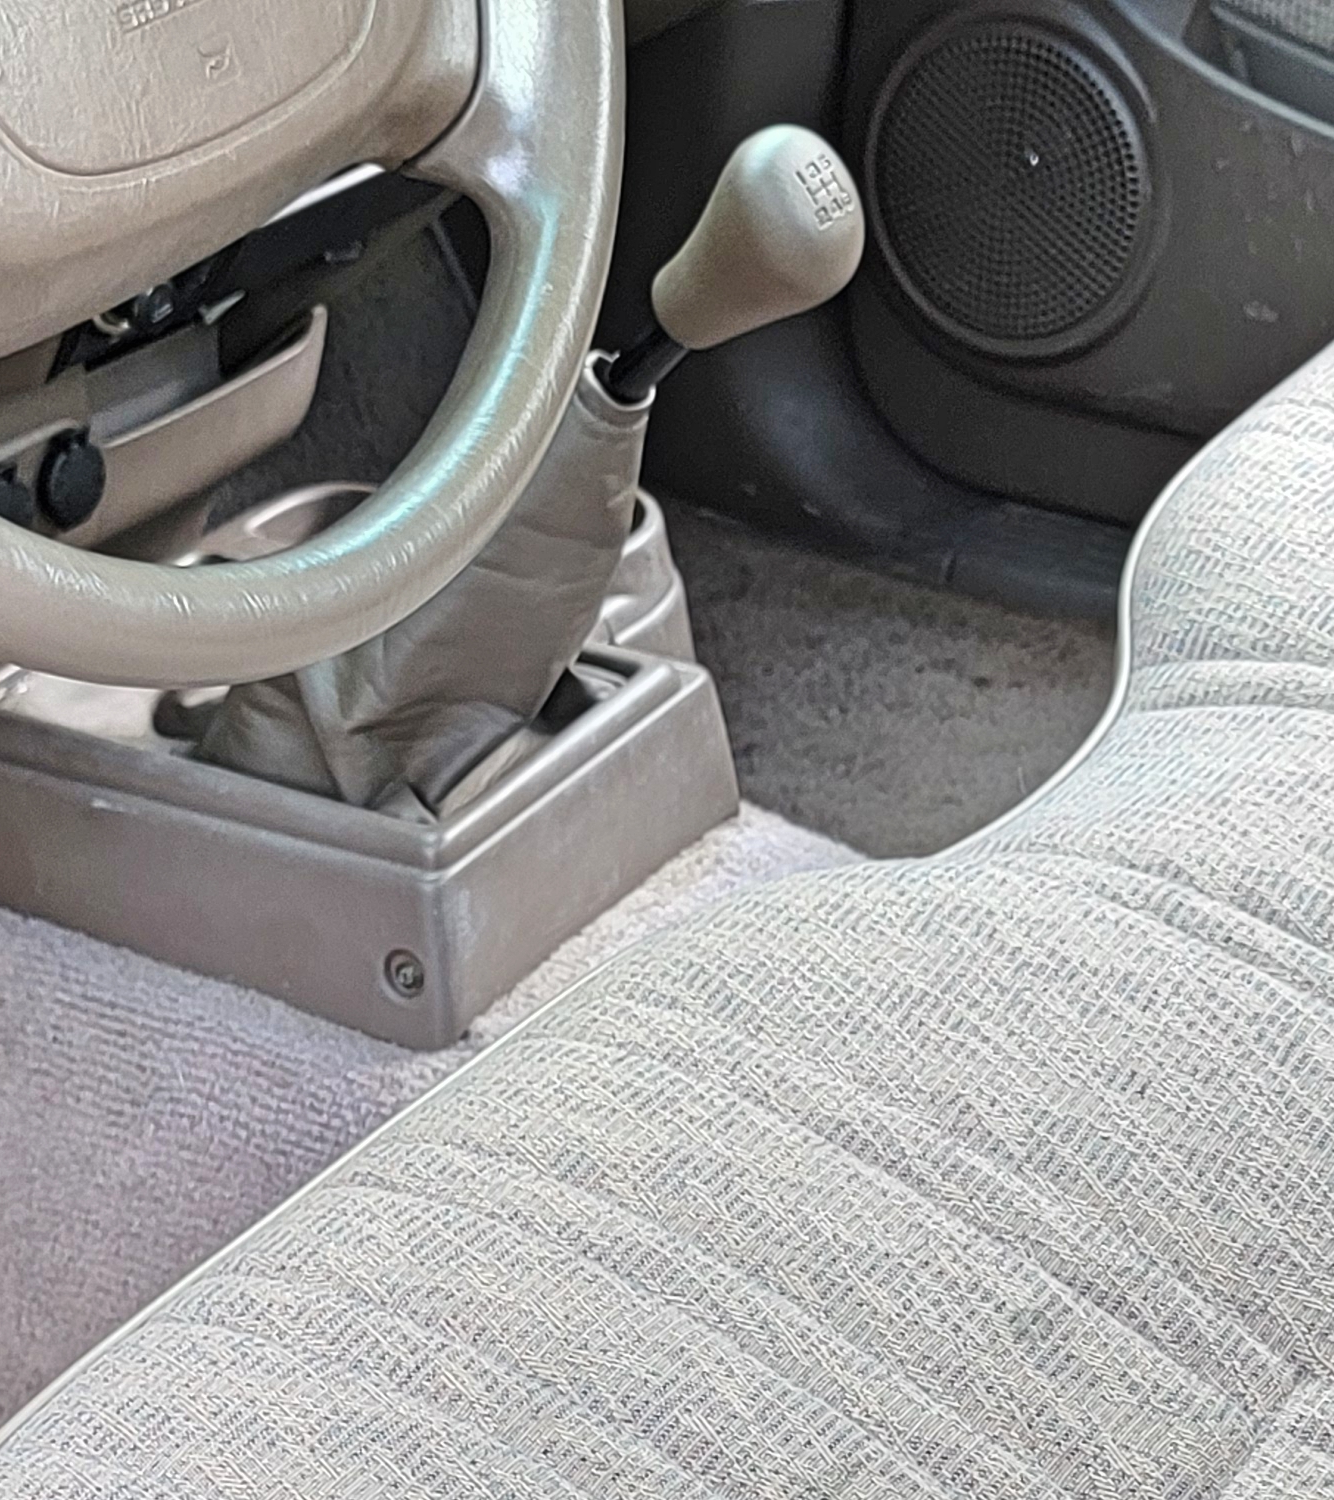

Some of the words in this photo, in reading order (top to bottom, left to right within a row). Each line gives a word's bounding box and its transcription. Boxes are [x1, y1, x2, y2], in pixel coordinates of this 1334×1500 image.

[805, 162, 822, 178] 3
[817, 154, 832, 170] 5
[814, 206, 834, 225] 2
[830, 197, 843, 214] 4
